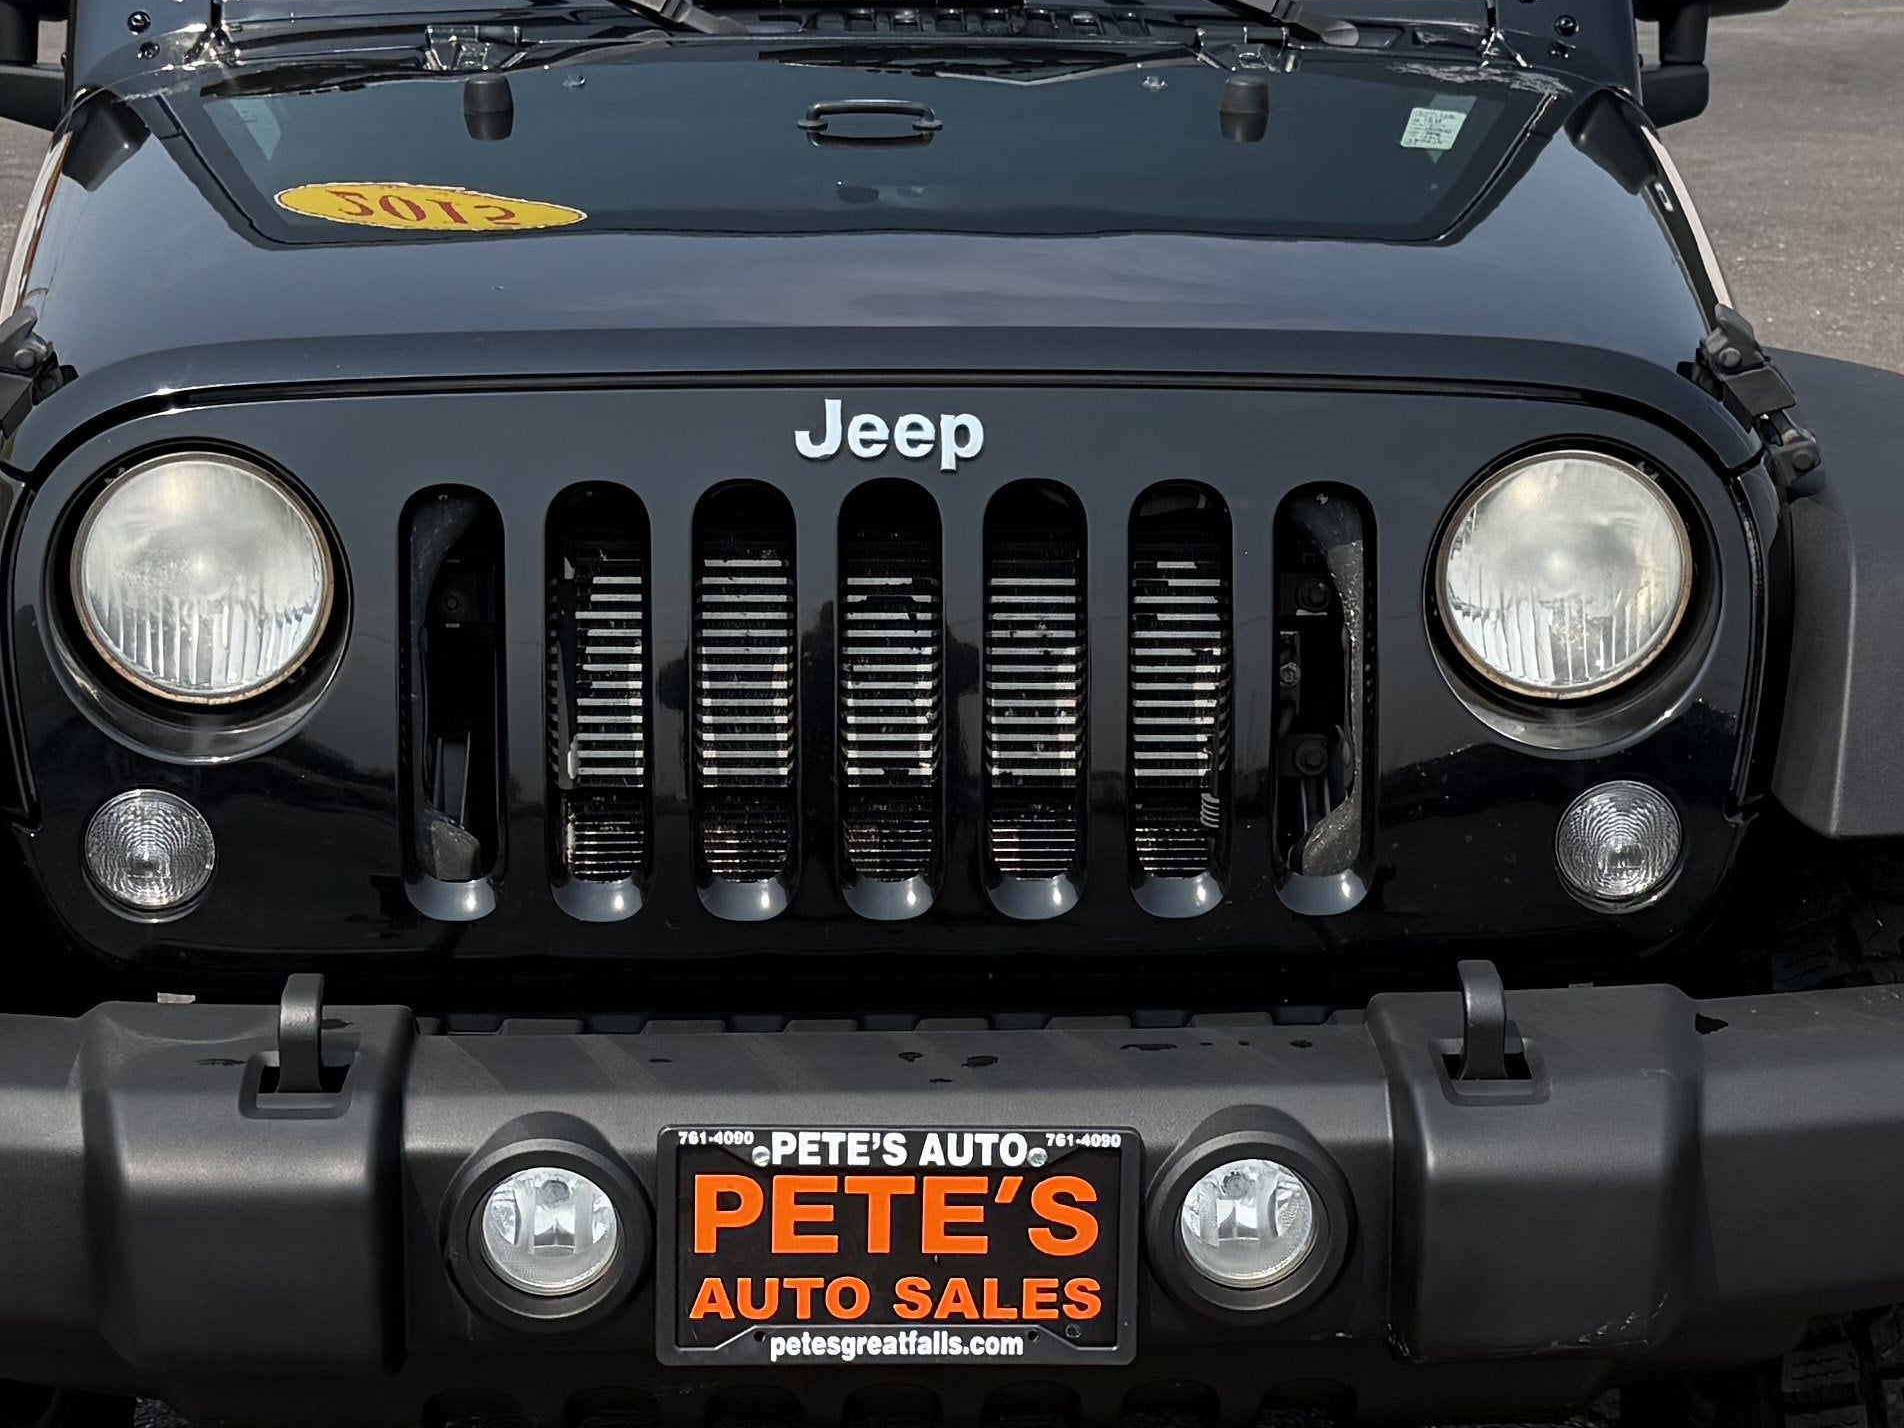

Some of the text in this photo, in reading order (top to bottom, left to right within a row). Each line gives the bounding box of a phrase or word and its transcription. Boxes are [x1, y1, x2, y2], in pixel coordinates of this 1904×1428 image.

[794, 398, 985, 473] Jeep
[677, 1130, 754, 1146] 761-4090
[771, 1132, 1029, 1167] PETE'S AUTO
[1045, 1133, 1122, 1149] 761-4090
[693, 1173, 1100, 1257] PETE'S
[688, 1276, 1103, 1320] AUTO SALES
[769, 1330, 1025, 1363] petesgreatfalls.com
